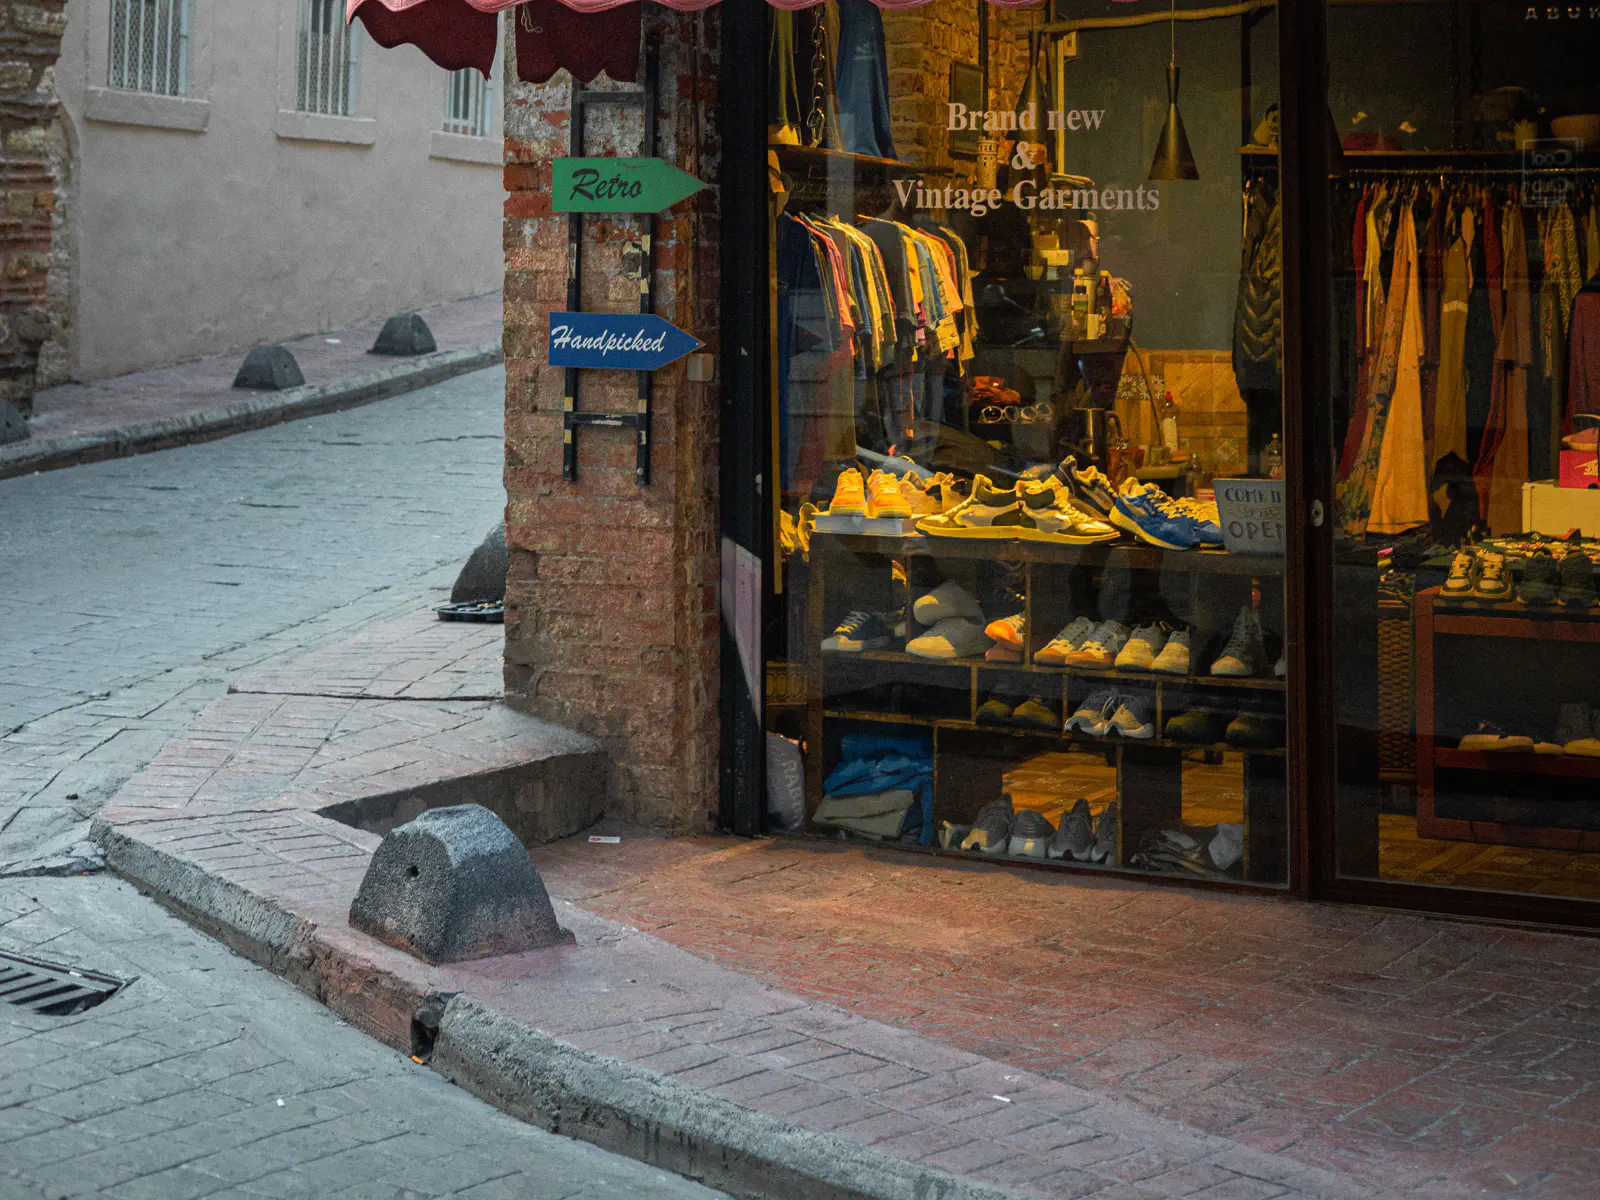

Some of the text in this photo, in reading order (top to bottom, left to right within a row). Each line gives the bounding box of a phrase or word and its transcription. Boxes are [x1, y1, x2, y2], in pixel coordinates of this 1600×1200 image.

[946, 102, 1105, 131] Brand new
[1011, 141, 1037, 170] &
[569, 167, 644, 201] Retro
[892, 179, 1002, 217] Vintage
[1013, 180, 1160, 211] Garments
[551, 324, 665, 356] Handpicked
